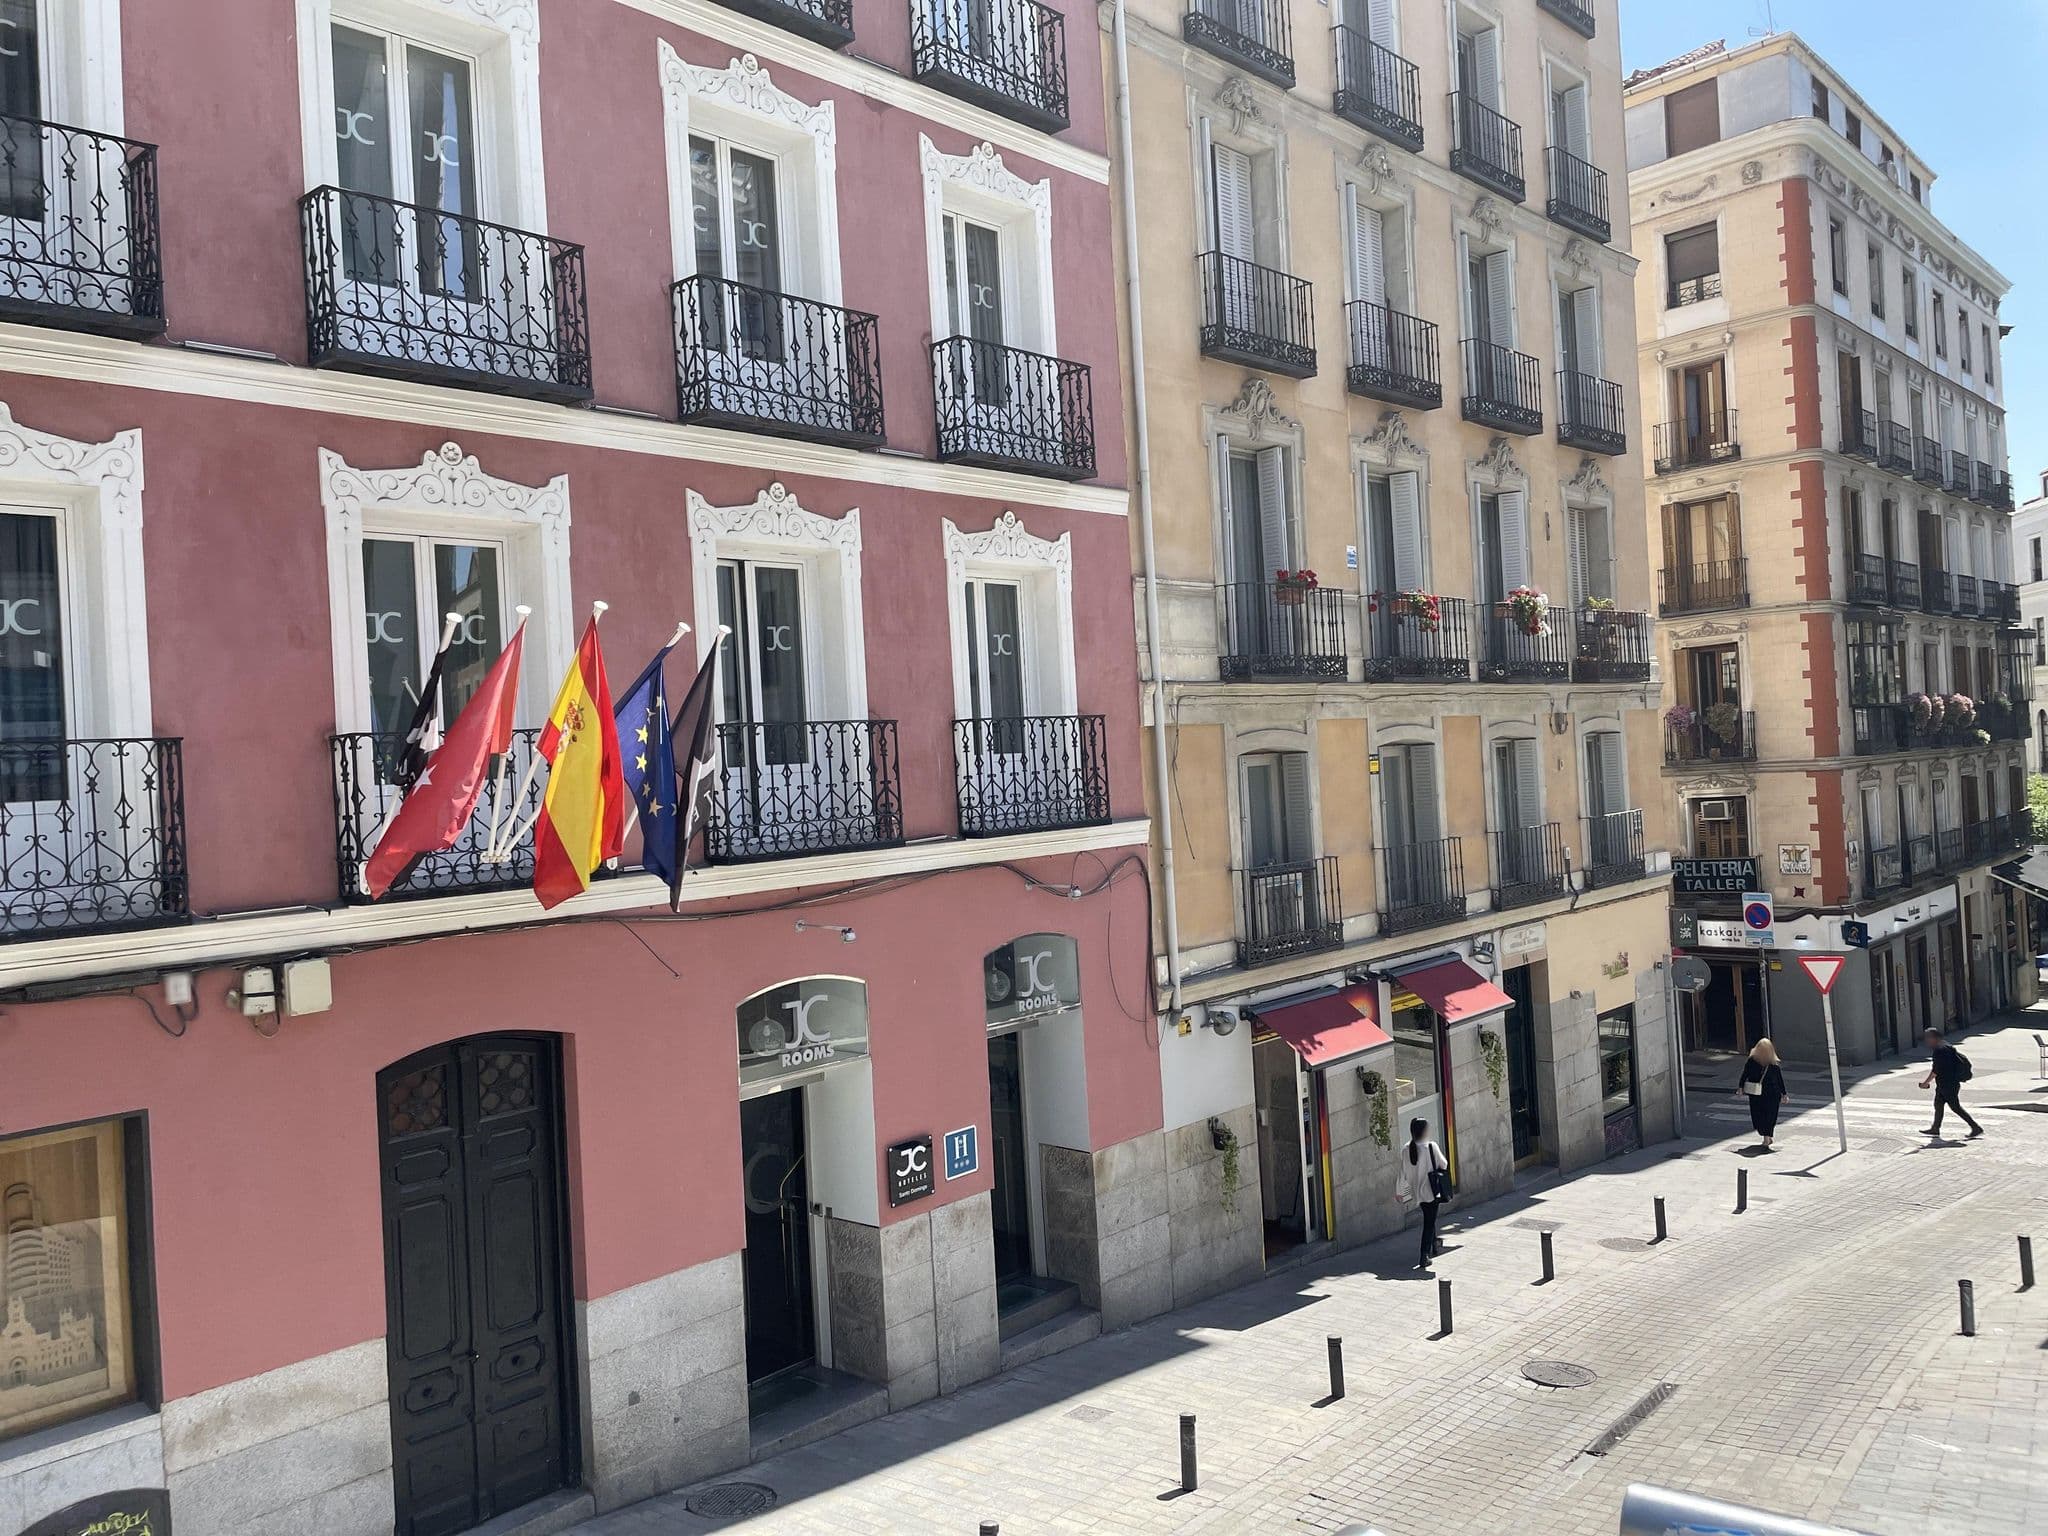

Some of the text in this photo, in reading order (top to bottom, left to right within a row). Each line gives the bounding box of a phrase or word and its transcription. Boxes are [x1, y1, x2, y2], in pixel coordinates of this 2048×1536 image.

[337, 107, 376, 145] JC
[424, 130, 460, 166] JC
[743, 219, 768, 248] JC
[974, 283, 993, 309] JC
[0, 598, 41, 635] JC
[366, 611, 404, 643] JC
[767, 625, 792, 651] JC
[993, 634, 1012, 656] JC
[1673, 860, 1755, 877] PELETERIA
[1683, 878, 1747, 891] TALLER
[1699, 925, 1743, 938] kaskais
[1017, 951, 1055, 997] JC
[1018, 993, 1058, 1013] ROOMS
[782, 994, 831, 1050] JC
[782, 1044, 835, 1068] ROOMS
[896, 1145, 928, 1177] JC
